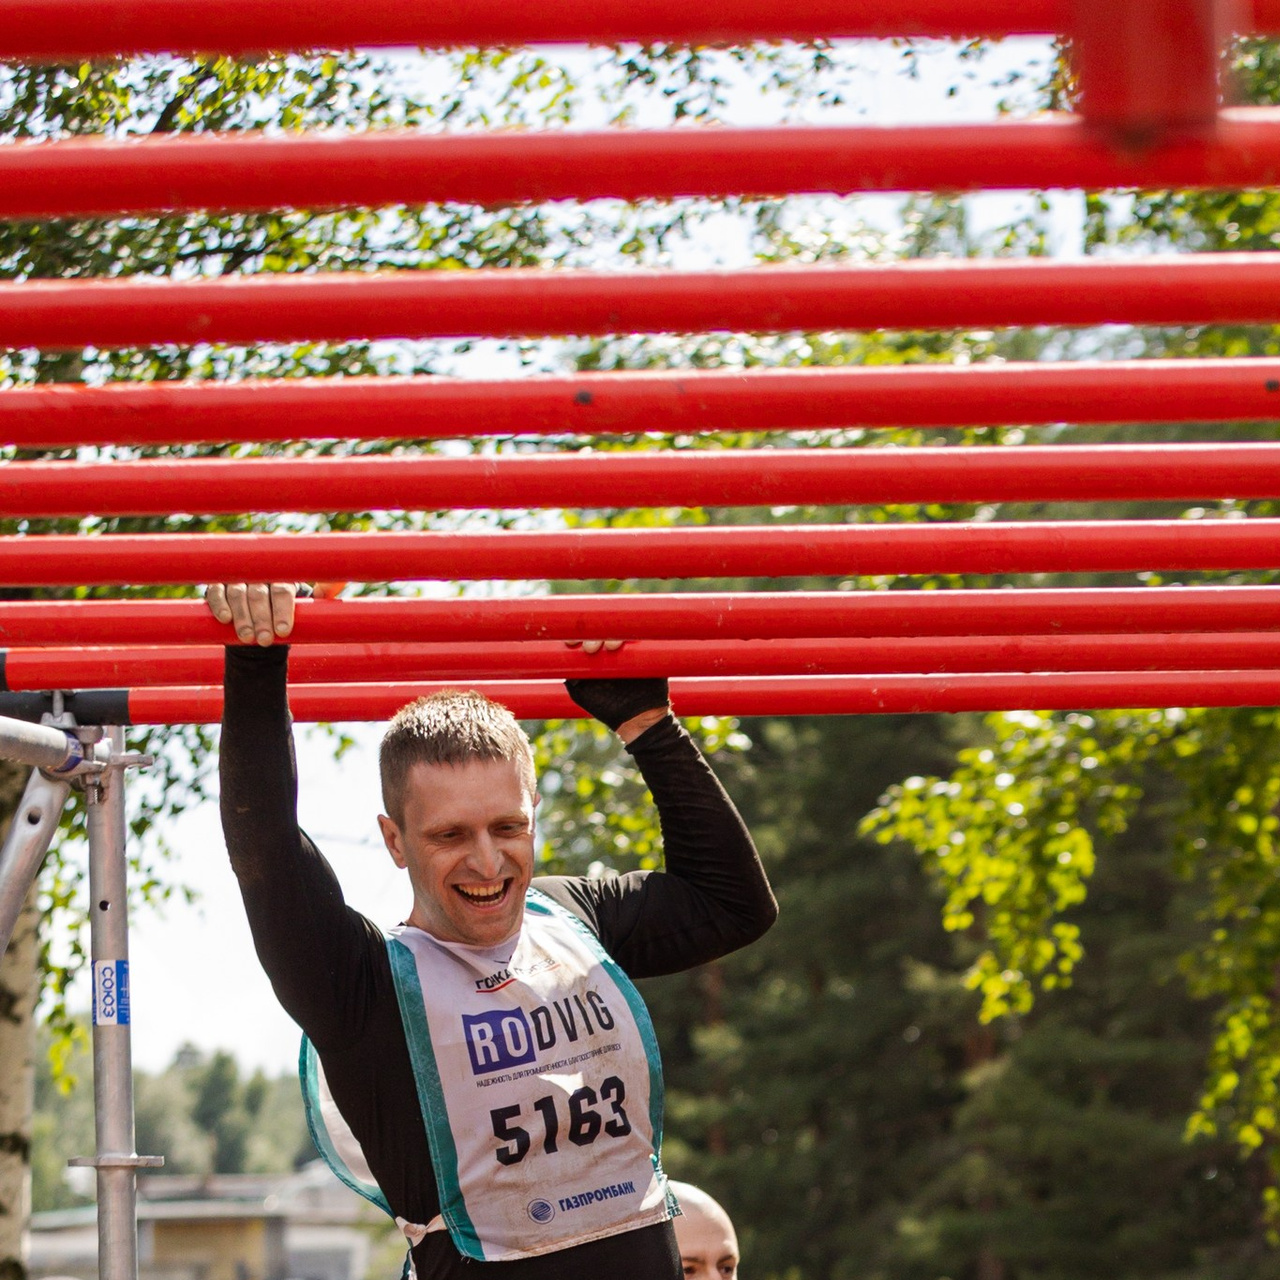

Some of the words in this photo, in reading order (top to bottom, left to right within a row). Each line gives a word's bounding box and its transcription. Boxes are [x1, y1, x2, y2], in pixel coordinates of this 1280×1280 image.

[102, 966, 115, 1018] СОЮЗ
[469, 990, 615, 1066] RODVIG
[476, 1073, 512, 1088] НАДЕЖНОСТЬ
[489, 1075, 633, 1167] 5163
[558, 1181, 636, 1212] ГАЗПРОМБАНК
